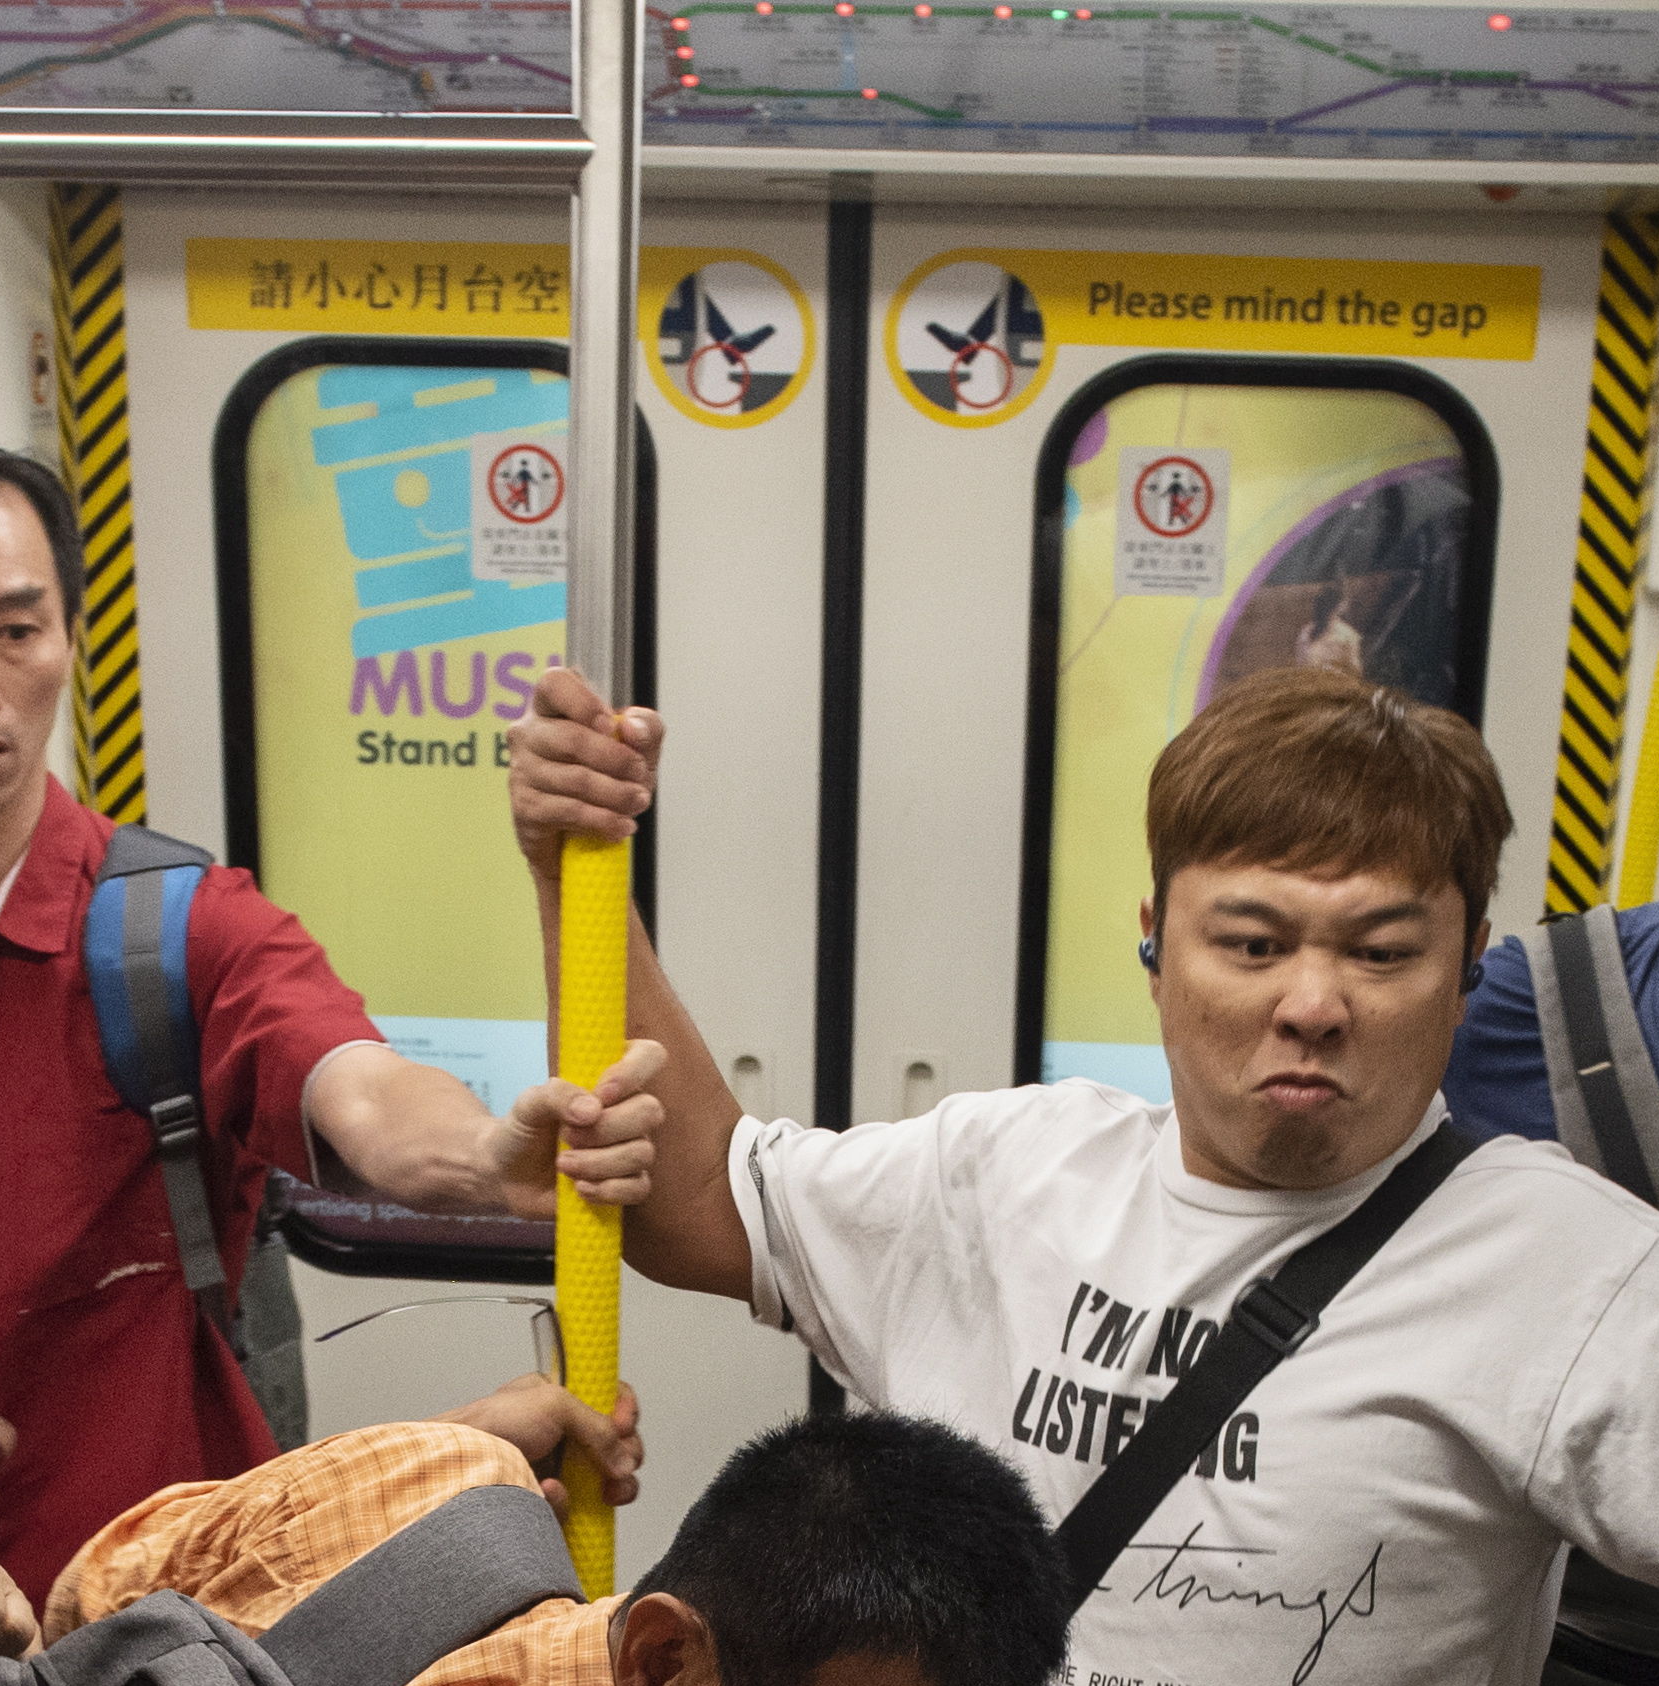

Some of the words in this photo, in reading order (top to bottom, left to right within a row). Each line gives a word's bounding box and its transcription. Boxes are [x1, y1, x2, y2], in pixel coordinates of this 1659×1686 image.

[250, 261, 560, 313] 請小心月台空
[1088, 281, 1212, 321] Please
[1223, 287, 1326, 325] mind
[1337, 290, 1402, 328] the
[1411, 301, 1488, 339] gap
[349, 650, 562, 720] MUS
[357, 730, 478, 768] Stand
[494, 731, 513, 767] b
[1061, 1281, 1149, 1371] I'M
[1146, 1306, 1220, 1378] NO
[1012, 1367, 1260, 1483] LISTEG
[1128, 1522, 1383, 1686] things
[1055, 1665, 1078, 1686] HE
